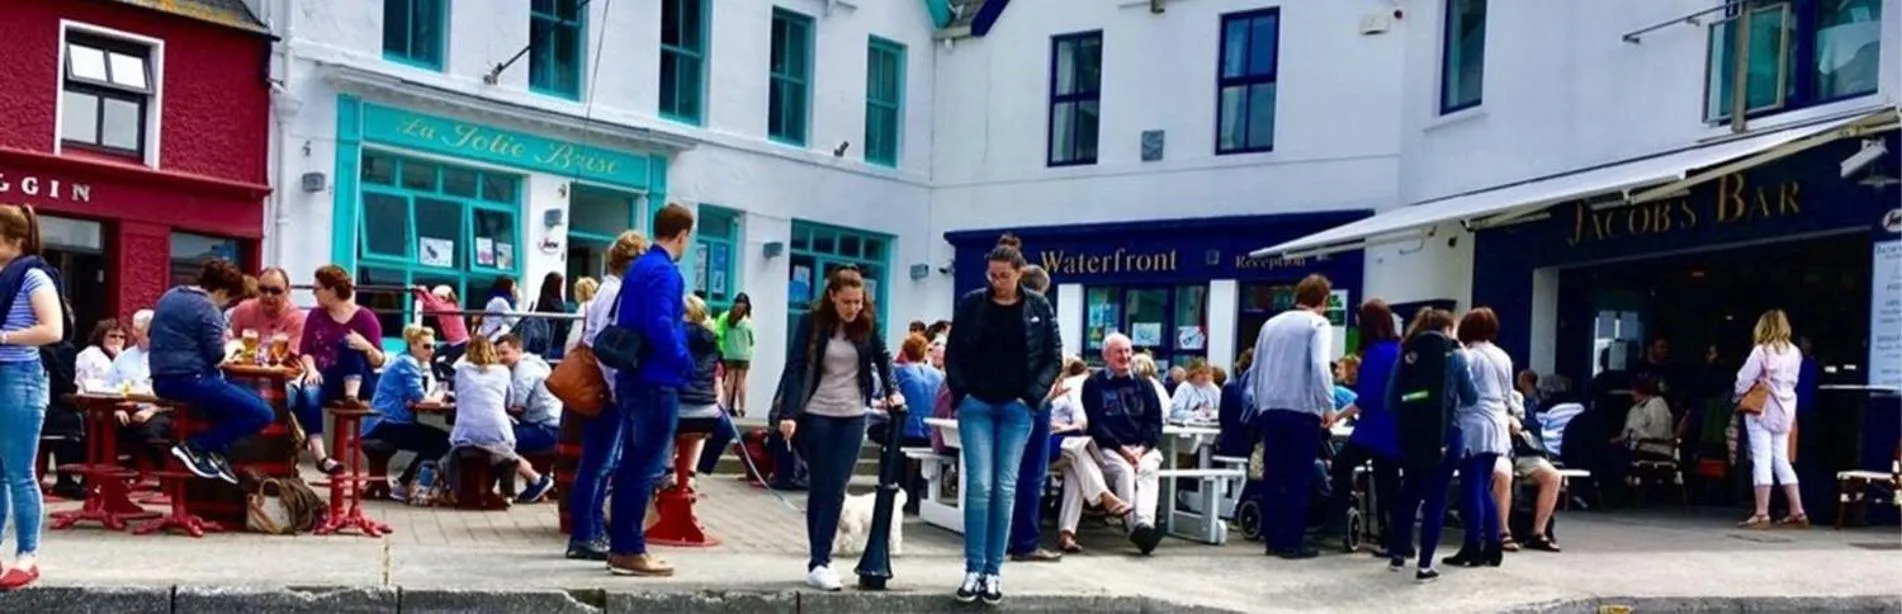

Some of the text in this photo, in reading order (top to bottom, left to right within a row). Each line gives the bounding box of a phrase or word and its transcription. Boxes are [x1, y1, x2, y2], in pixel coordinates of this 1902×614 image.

[397, 115, 618, 175] La Jolie Brise
[1566, 171, 1800, 248] JACOBS BAR
[1040, 247, 1178, 274] Waterfront
